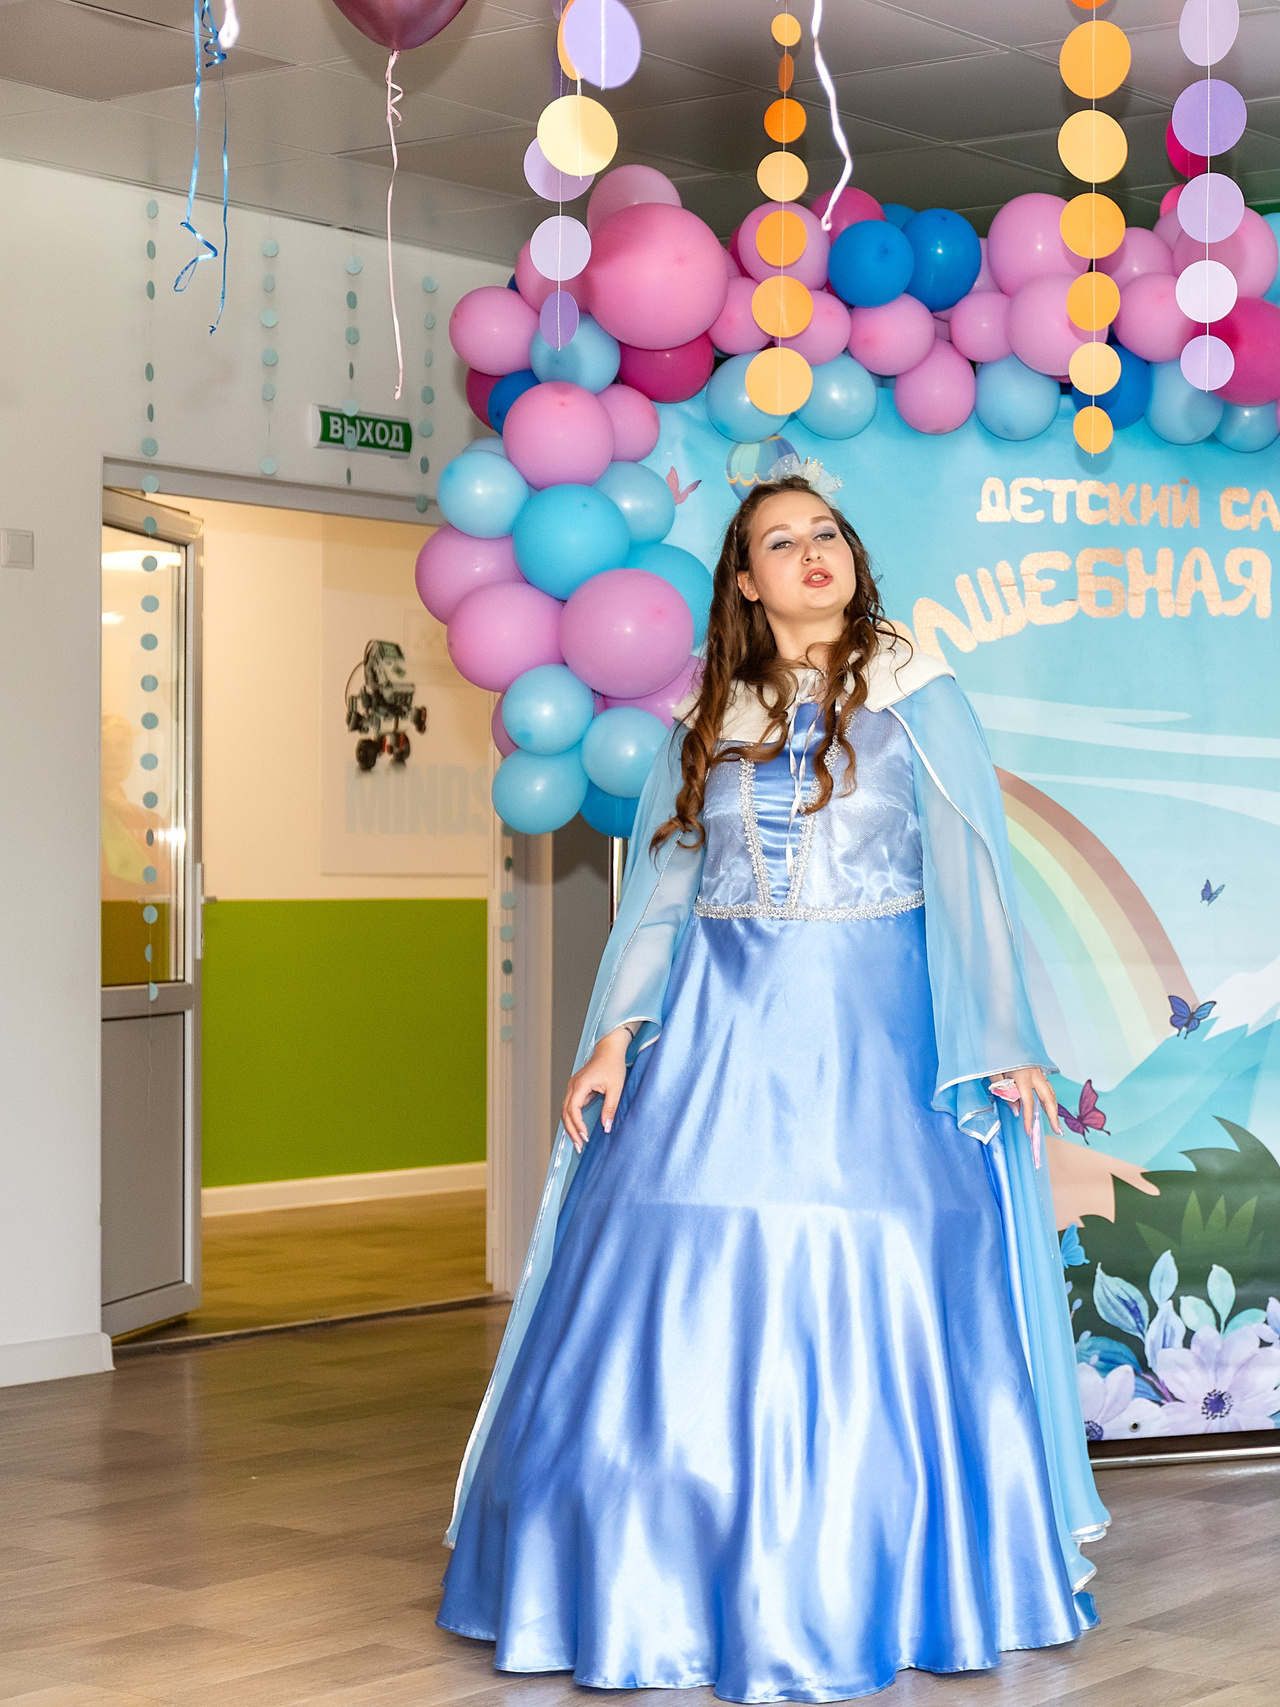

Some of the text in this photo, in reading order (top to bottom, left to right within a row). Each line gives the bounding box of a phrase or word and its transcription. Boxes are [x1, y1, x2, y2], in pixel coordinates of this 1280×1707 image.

[328, 415, 405, 450] ВЫХОД
[976, 477, 1200, 529] ДЕТСКИЙ
[876, 547, 1272, 666] ЛШЕБНАЯ
